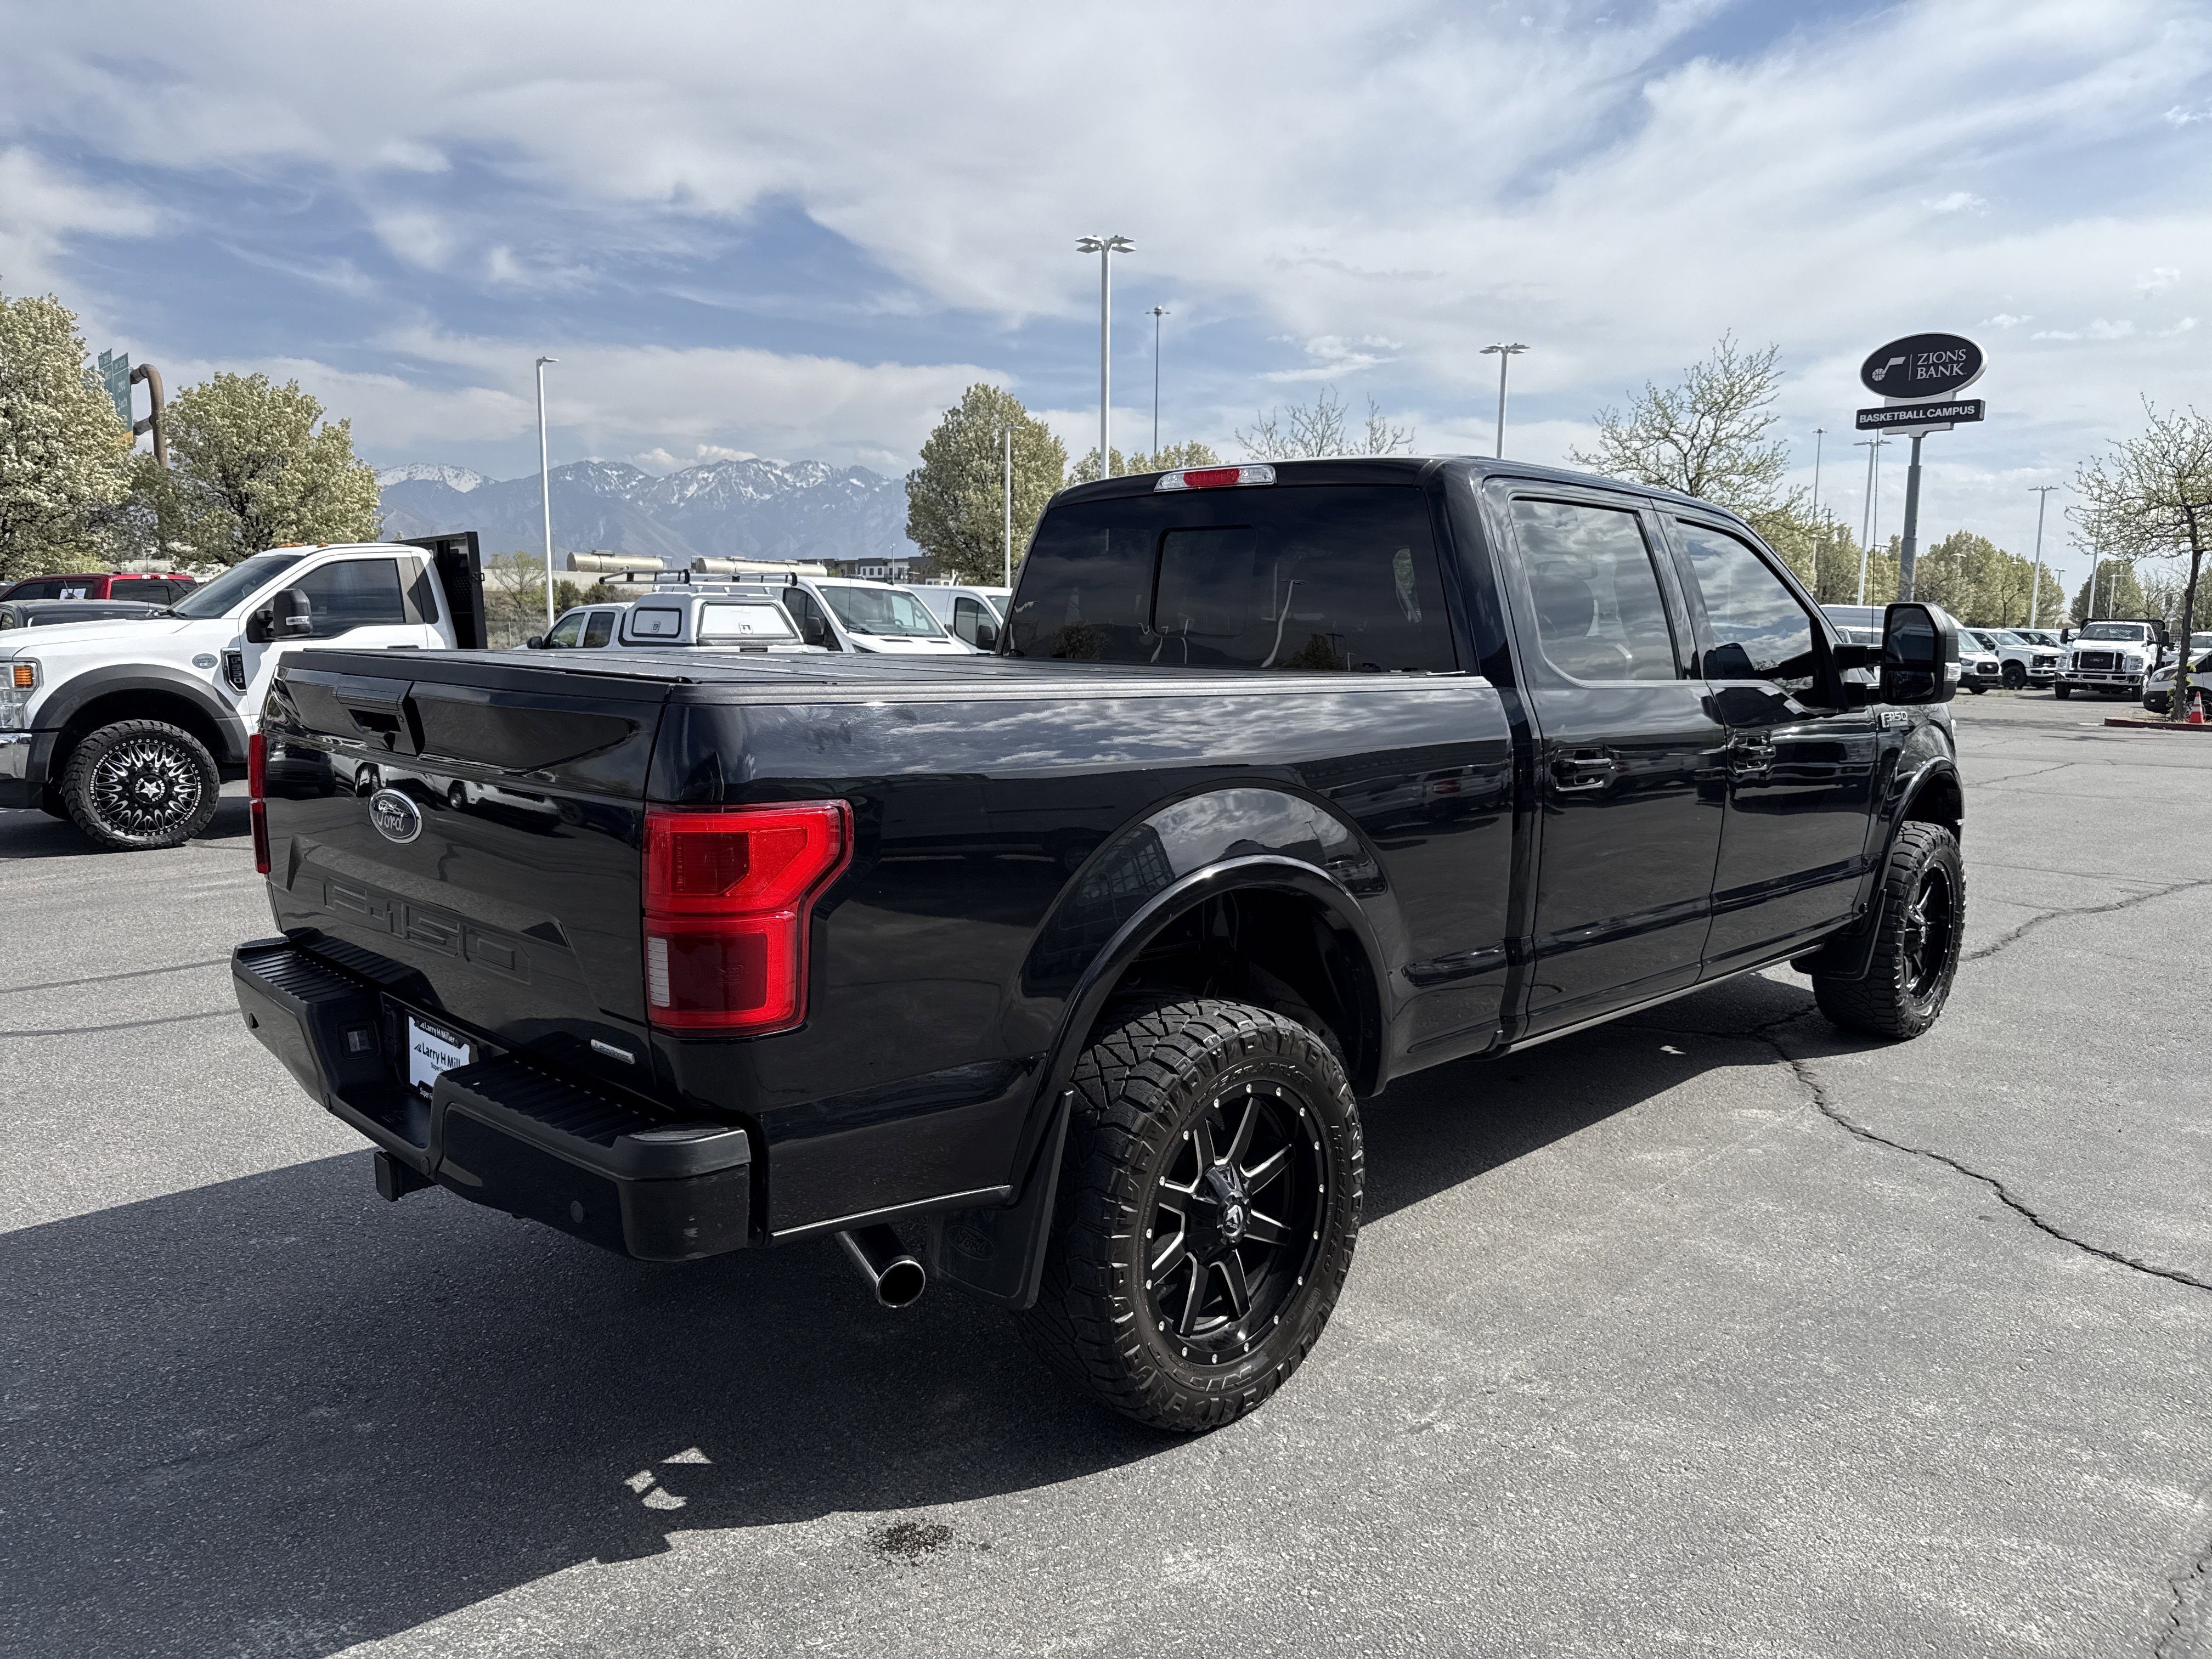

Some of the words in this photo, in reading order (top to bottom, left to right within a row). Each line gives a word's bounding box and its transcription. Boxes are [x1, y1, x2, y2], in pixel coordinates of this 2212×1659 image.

[1917, 348, 1966, 366] ZIONS
[1916, 363, 1966, 380] BANK
[1859, 410, 1926, 424] BASKETBALL
[1927, 405, 1975, 418] CAMPUS
[135, 777, 145, 794] FORCE
[376, 800, 404, 832] Ford
[424, 1022, 437, 1037] Larry
[436, 1028, 441, 1037] H
[441, 1030, 456, 1043] Miller
[422, 1042, 439, 1065] Larry
[441, 1051, 446, 1065] H
[447, 1055, 464, 1070] Mill
[956, 1228, 986, 1254] Ford
